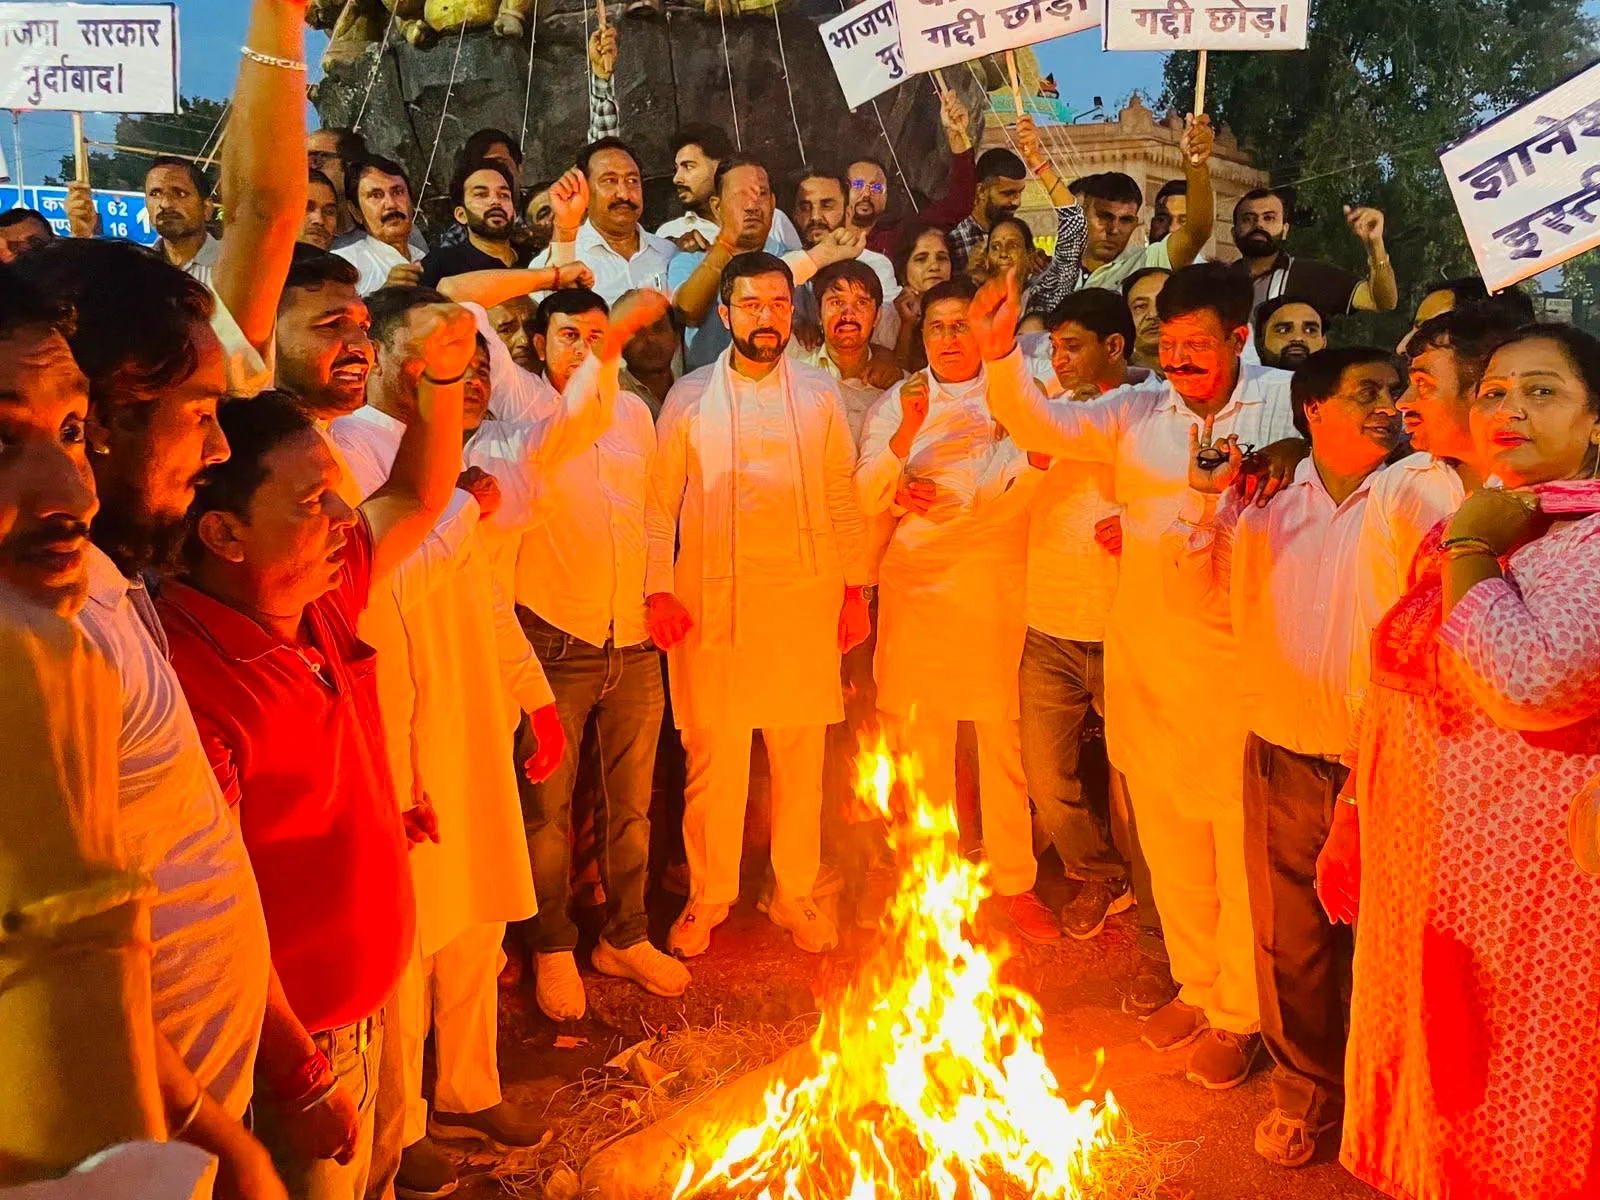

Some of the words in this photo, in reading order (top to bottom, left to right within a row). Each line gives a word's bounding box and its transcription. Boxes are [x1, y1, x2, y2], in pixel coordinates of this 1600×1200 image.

[77, 19, 161, 47] सरकार
[921, 8, 986, 48] गद्दी
[1131, 0, 1195, 40] गद्दी
[107, 201, 129, 217] 62
[109, 222, 128, 237] 16
